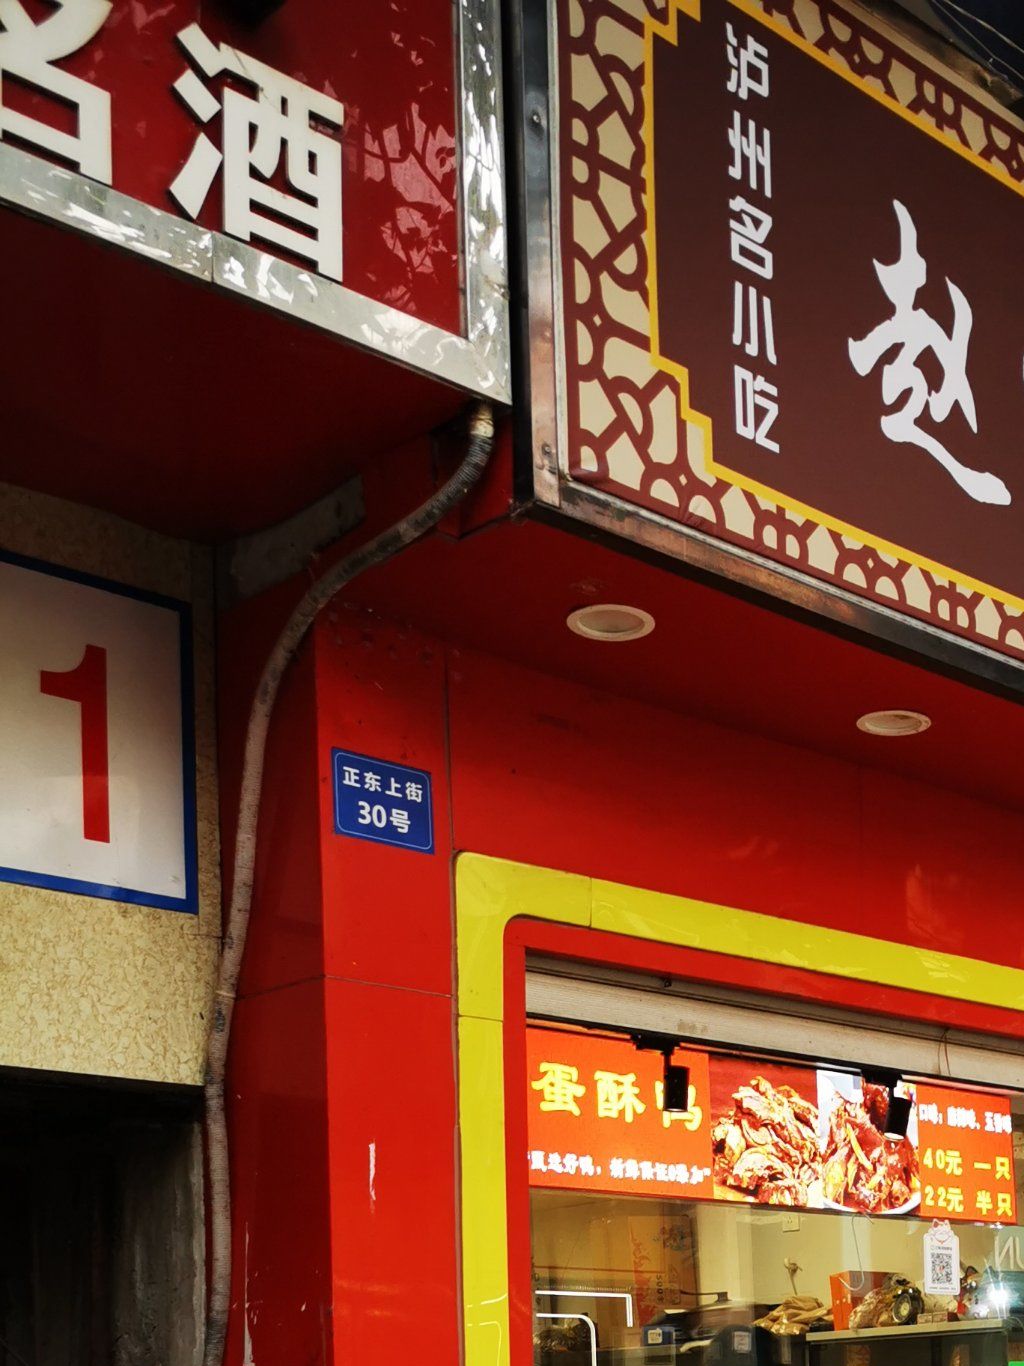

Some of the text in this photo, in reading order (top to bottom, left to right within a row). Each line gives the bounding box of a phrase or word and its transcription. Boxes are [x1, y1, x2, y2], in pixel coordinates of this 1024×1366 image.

[725, 21, 782, 455] 泸州名小吃
[39, 642, 111, 844] 1
[342, 766, 423, 803] 正东上街
[358, 800, 412, 834] 30号
[923, 1147, 1012, 1180] 40元 一只
[924, 1185, 1013, 1217] 22元 半只
